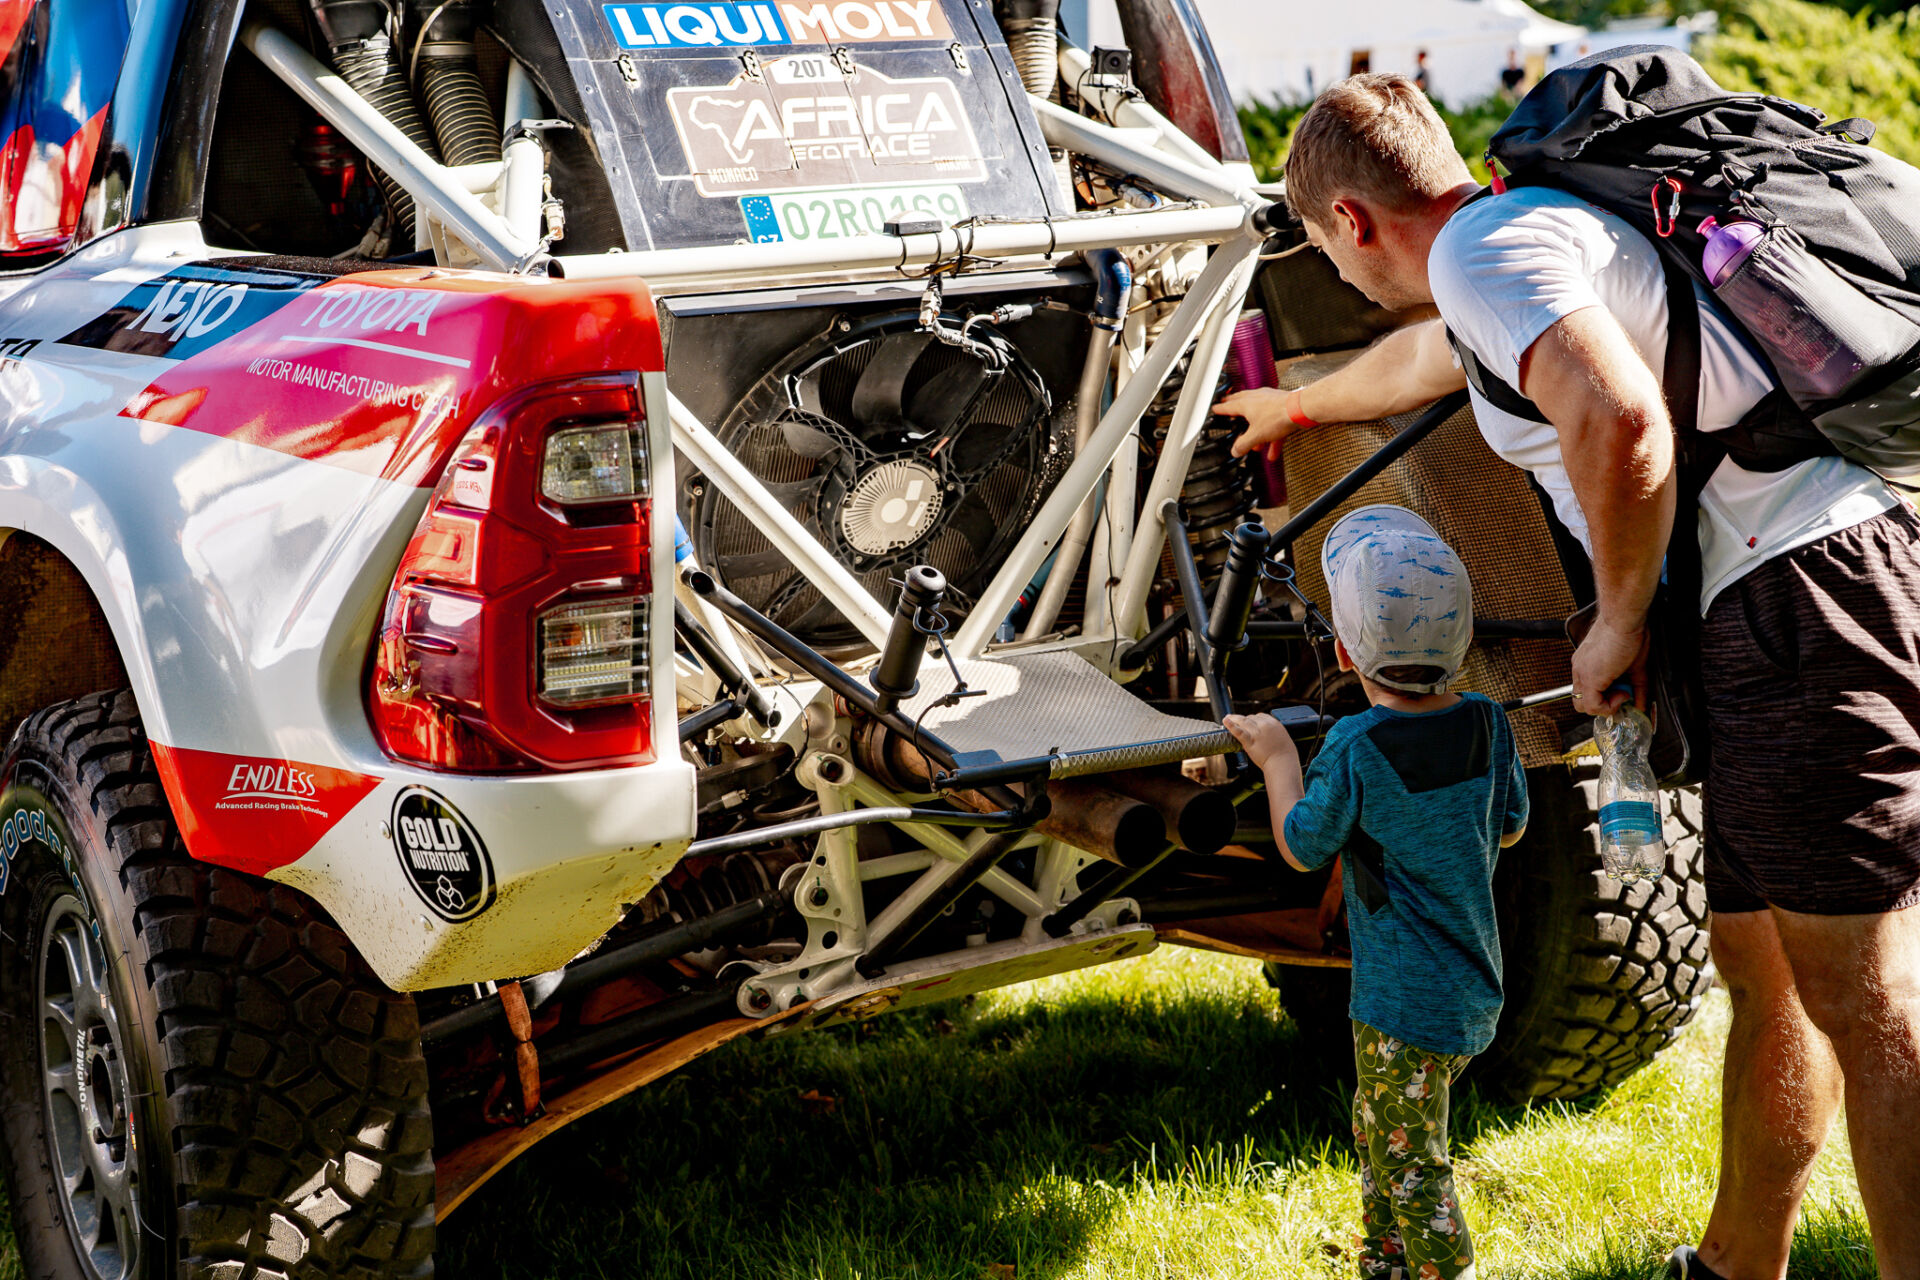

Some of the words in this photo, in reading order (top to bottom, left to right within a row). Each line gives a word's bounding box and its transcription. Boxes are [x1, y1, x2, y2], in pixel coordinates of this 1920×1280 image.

[612, 0, 783, 46] LIQUI
[782, 0, 932, 40] MOLY
[787, 58, 827, 79] 207
[731, 91, 958, 151] AFRICA
[707, 166, 760, 185] MONACO
[301, 290, 446, 336] TOYOTA
[246, 357, 295, 382] MOTOR
[291, 363, 409, 408] MANUFACTURING
[411, 388, 460, 420] CZECH
[226, 764, 316, 796] ENDLESS
[215, 802, 253, 810] Advanced
[254, 802, 280, 811] Racing
[280, 803, 300, 811] Brake
[300, 805, 329, 819] Technology
[400, 816, 462, 851] GOLD
[409, 849, 470, 872] NUTRITION
